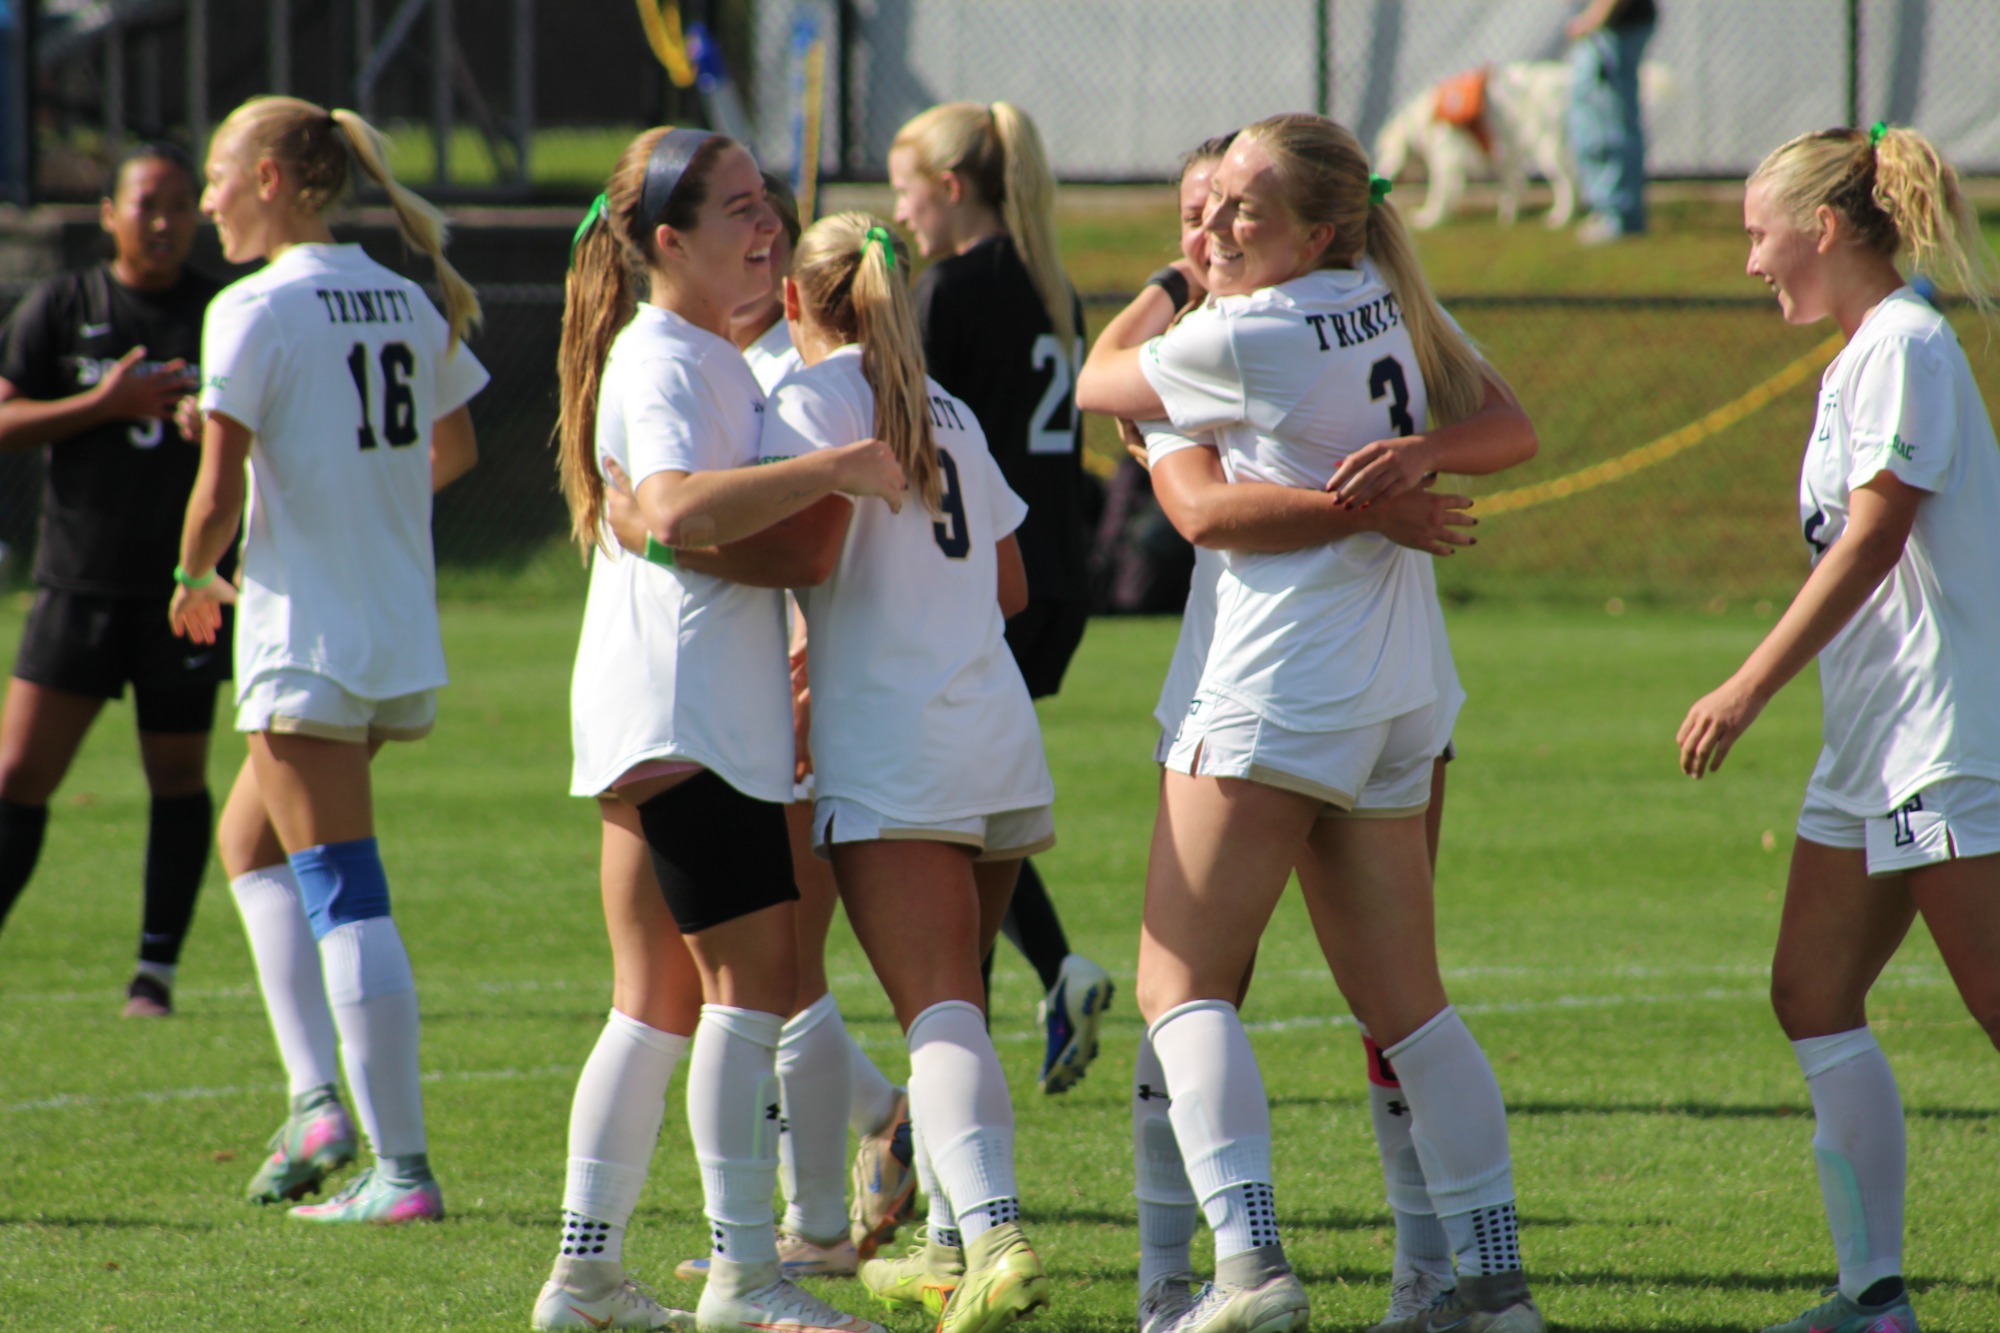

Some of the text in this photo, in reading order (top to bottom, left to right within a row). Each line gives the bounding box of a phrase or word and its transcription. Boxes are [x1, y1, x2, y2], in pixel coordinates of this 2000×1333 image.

[316, 288, 413, 323] TRINITY
[1305, 292, 1404, 351] TRINIT
[347, 341, 419, 450] 16
[922, 447, 972, 561] 9
[1887, 793, 1923, 847] T
